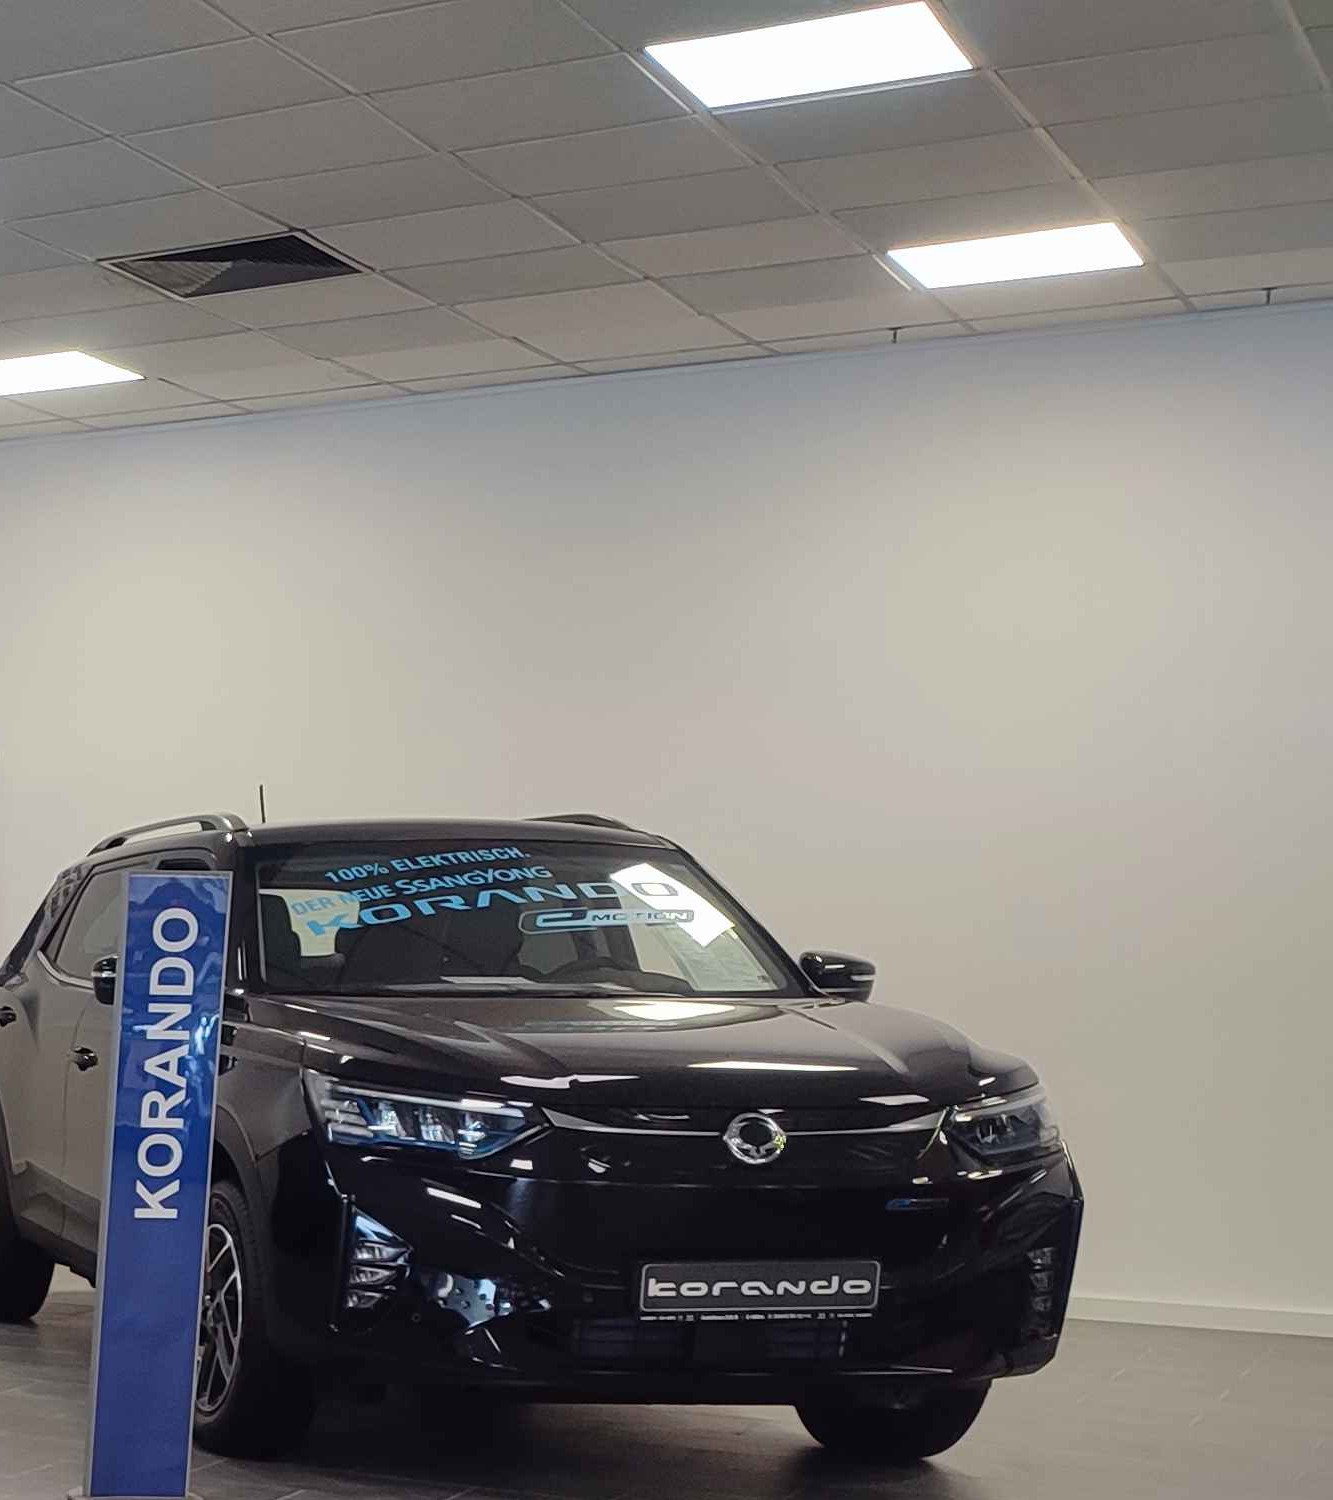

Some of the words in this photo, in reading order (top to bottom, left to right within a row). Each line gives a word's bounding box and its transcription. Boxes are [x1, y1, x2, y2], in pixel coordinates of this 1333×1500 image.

[324, 863, 389, 884] 100%
[388, 846, 531, 873] ELEKTRISCH.
[291, 895, 335, 916] DER
[340, 883, 396, 906] NEUE
[306, 881, 679, 937] KORANDO
[134, 907, 199, 1220] KORANDO
[647, 1275, 872, 1297] korando
